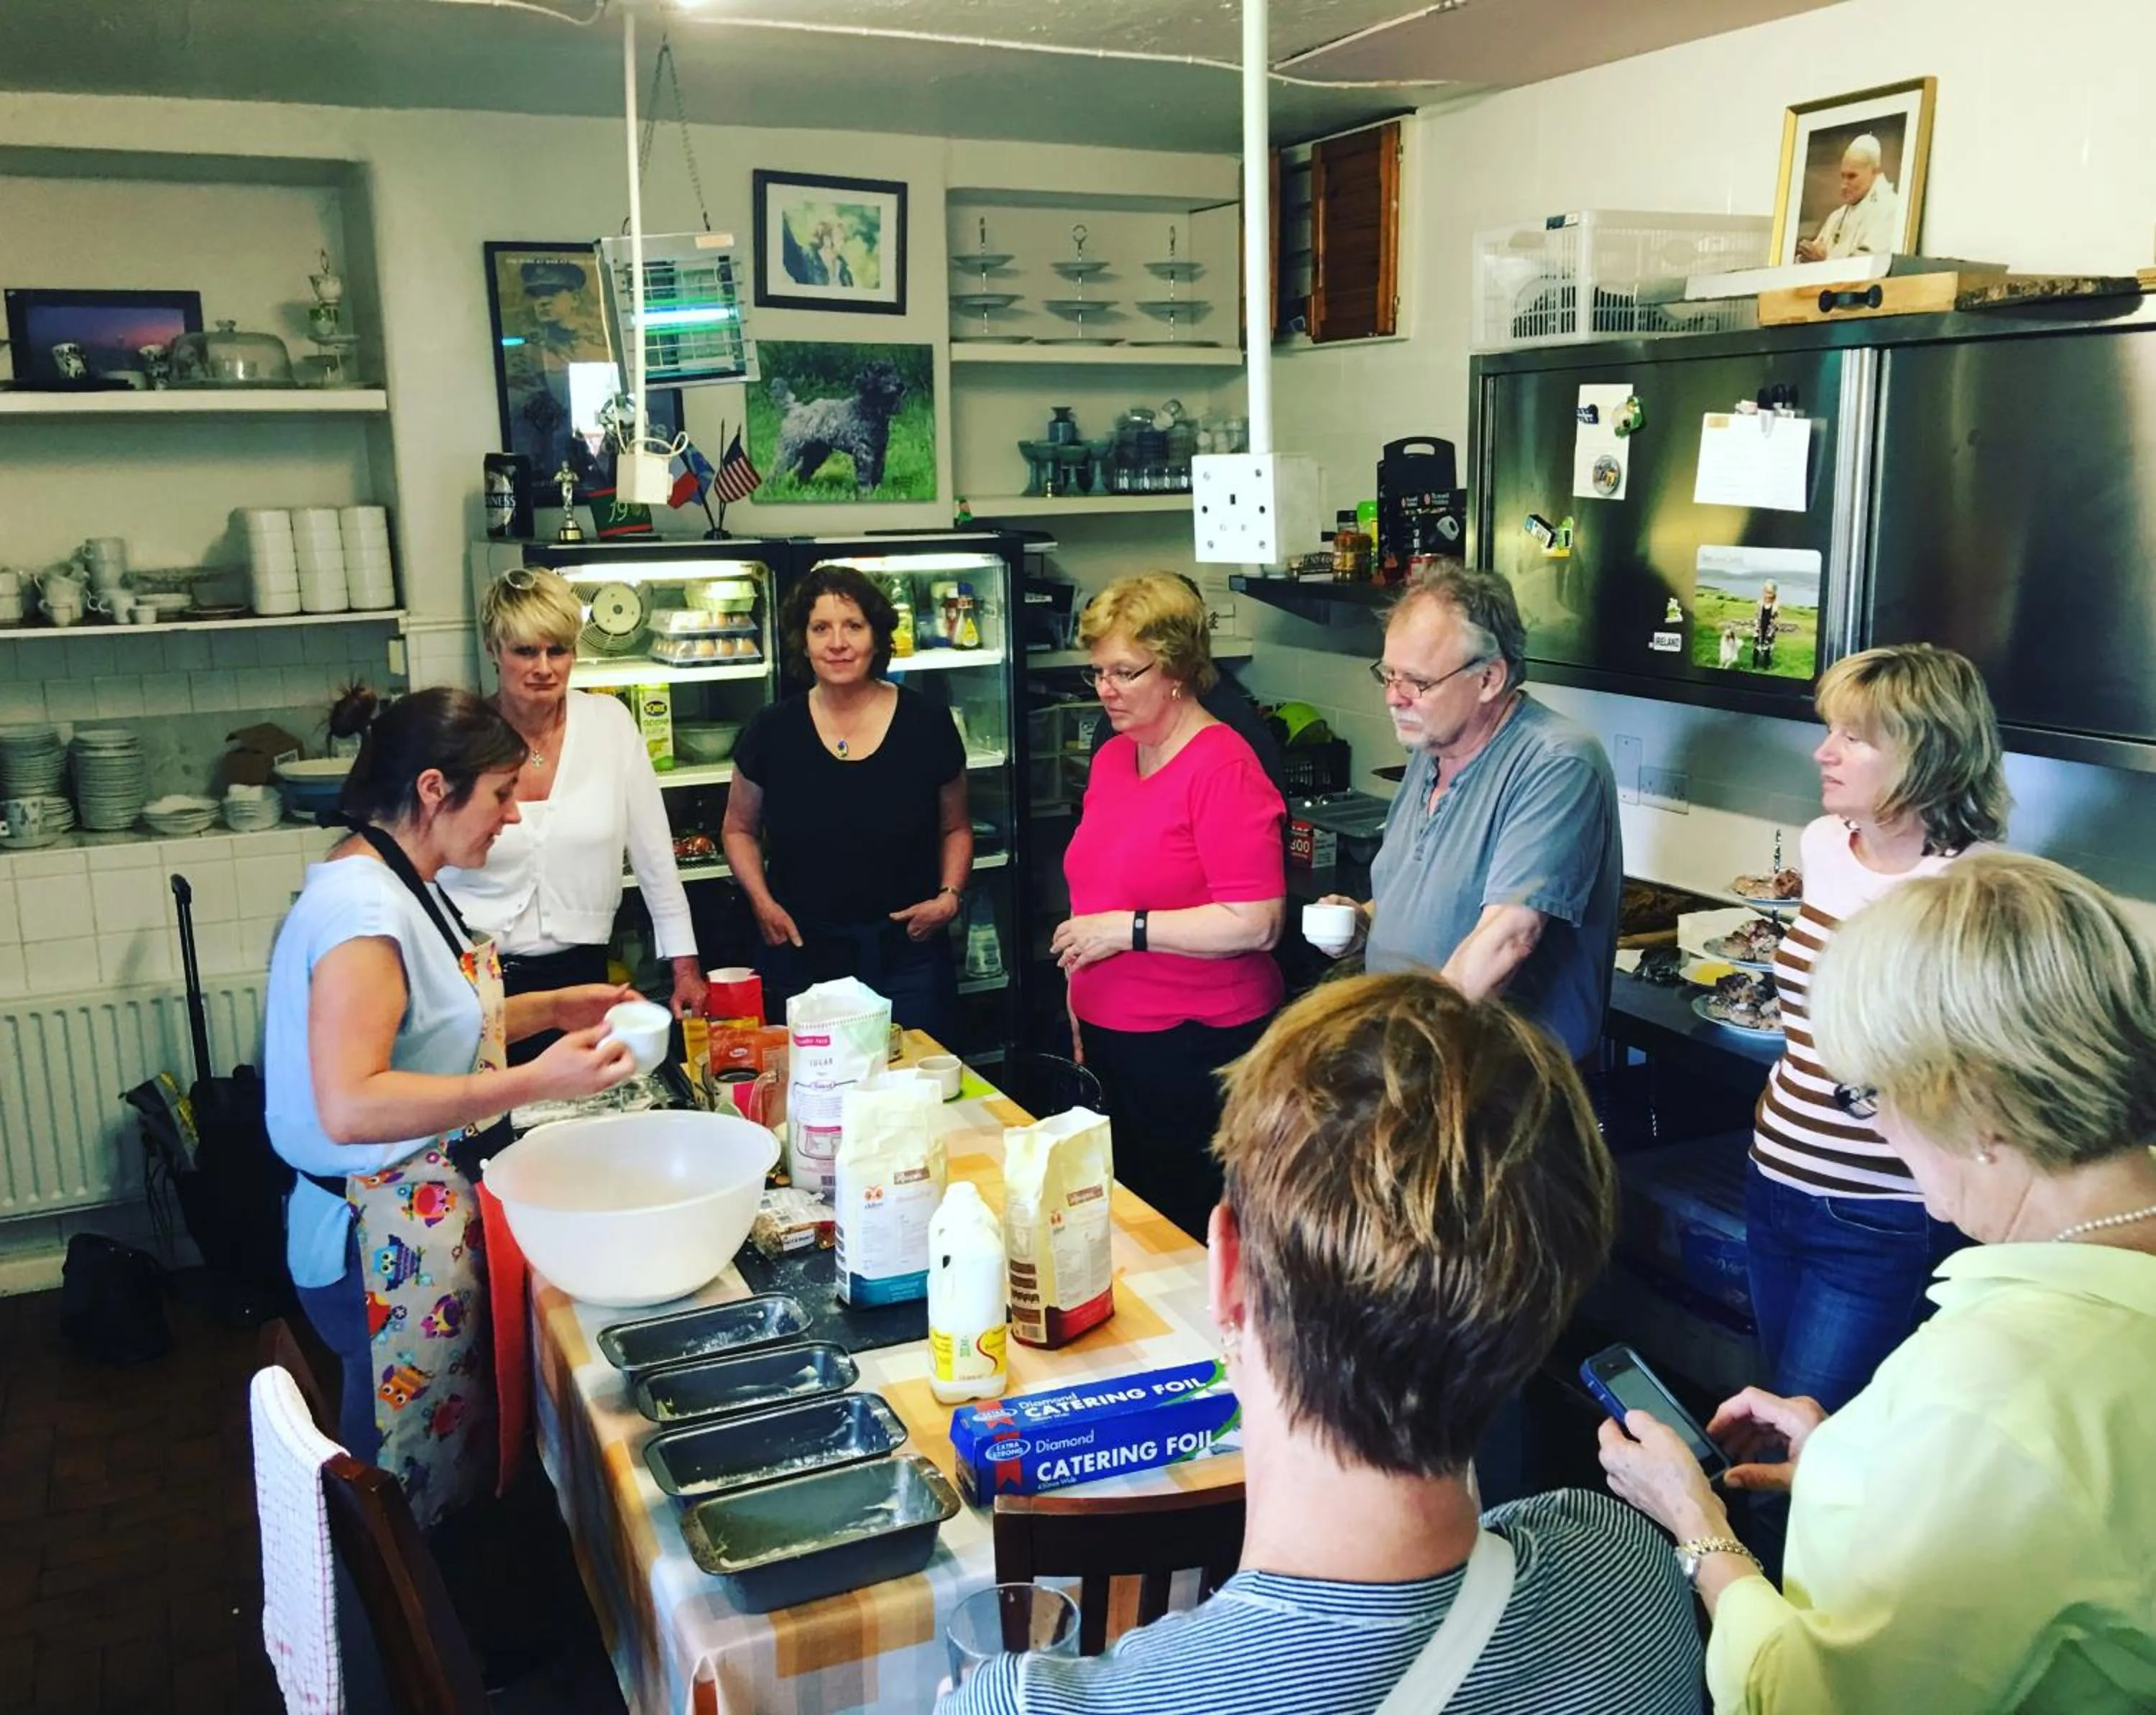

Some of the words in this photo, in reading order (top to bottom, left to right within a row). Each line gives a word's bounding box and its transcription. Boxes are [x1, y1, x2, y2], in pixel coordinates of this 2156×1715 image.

[1018, 1392, 1078, 1410] Diamond
[1024, 1388, 1147, 1417] CATERING
[1151, 1378, 1207, 1395] FOIL
[995, 1441, 1020, 1450] EXTRA
[1036, 1428, 1095, 1453] Diamond
[992, 1447, 1024, 1458] STRONG
[1037, 1440, 1158, 1481] CATERING
[1166, 1430, 1216, 1456] FOIL
